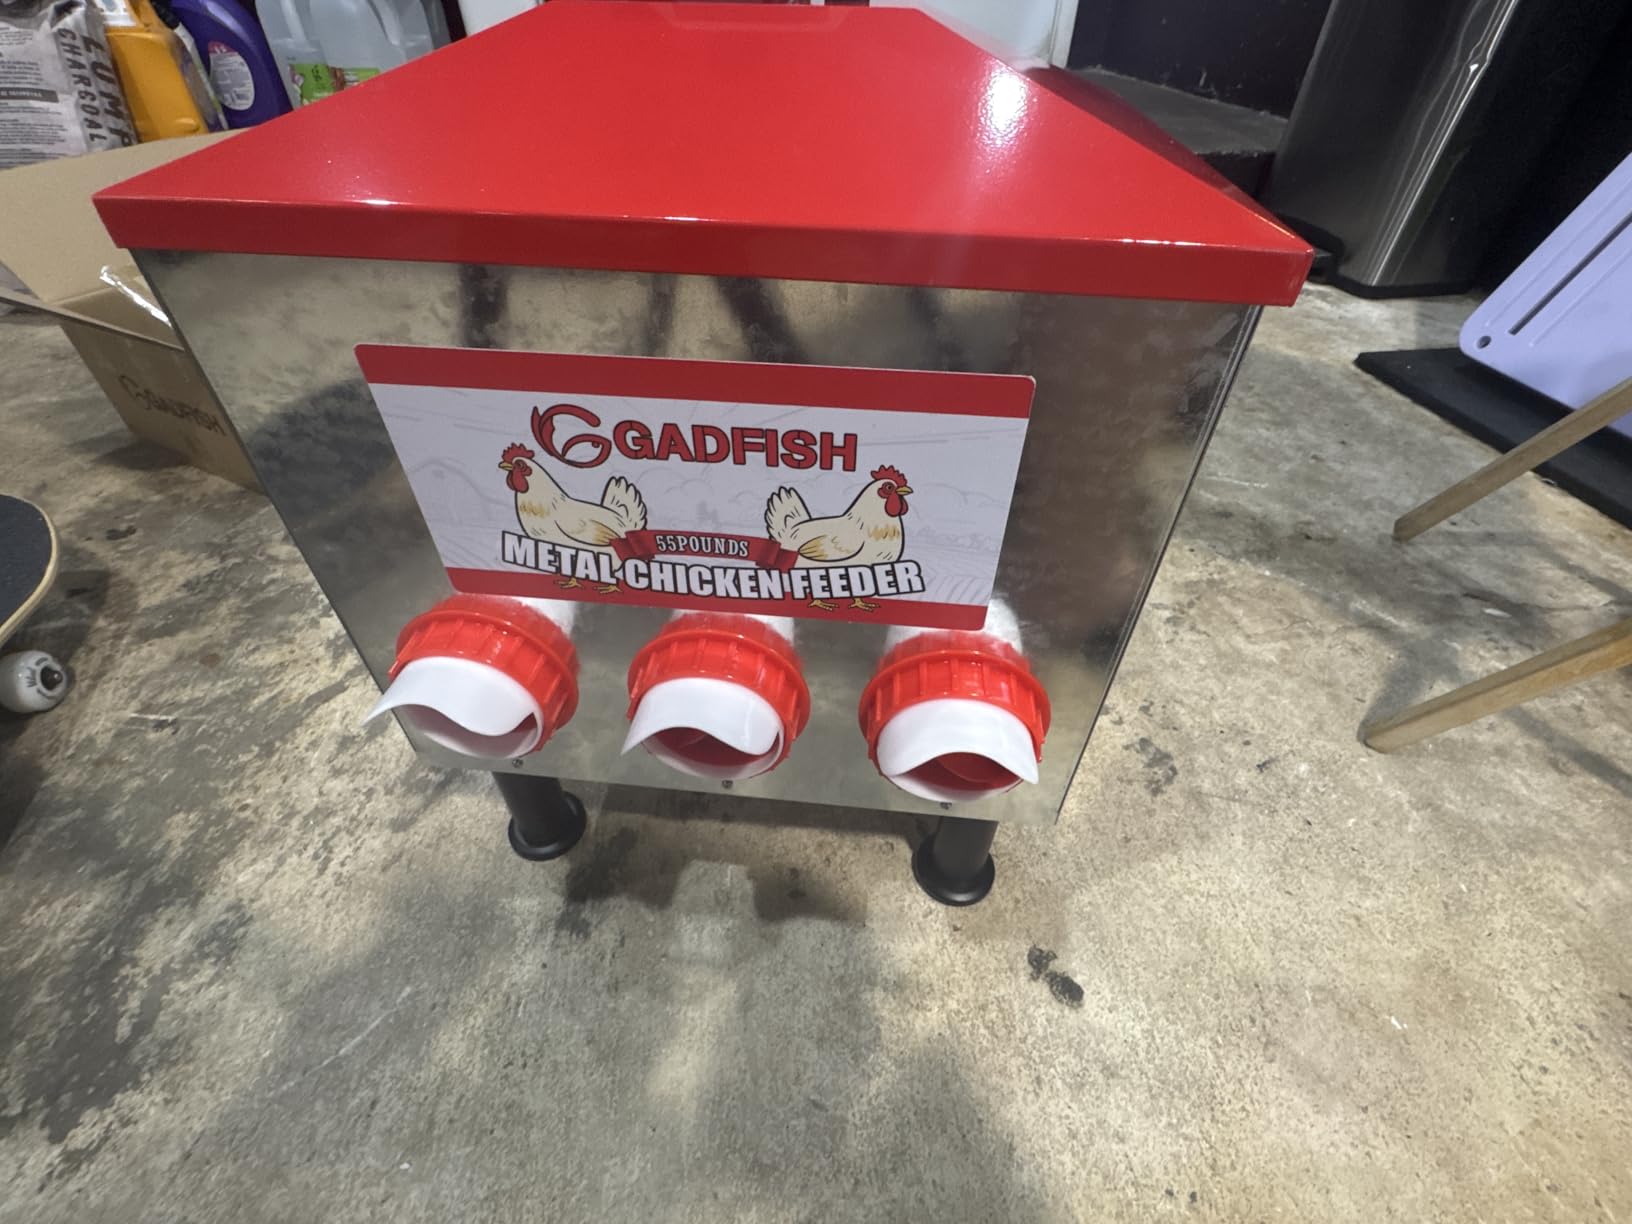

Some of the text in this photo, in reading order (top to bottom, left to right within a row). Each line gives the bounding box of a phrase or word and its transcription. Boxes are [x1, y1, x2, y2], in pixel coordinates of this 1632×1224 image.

[57, 27, 108, 142] CHARCOAL
[81, 34, 133, 148] LUMP
[612, 419, 858, 472] GADFISH
[502, 530, 926, 601] METAL CHICKEN FEEDER
[655, 534, 749, 558] 55POUNDS
